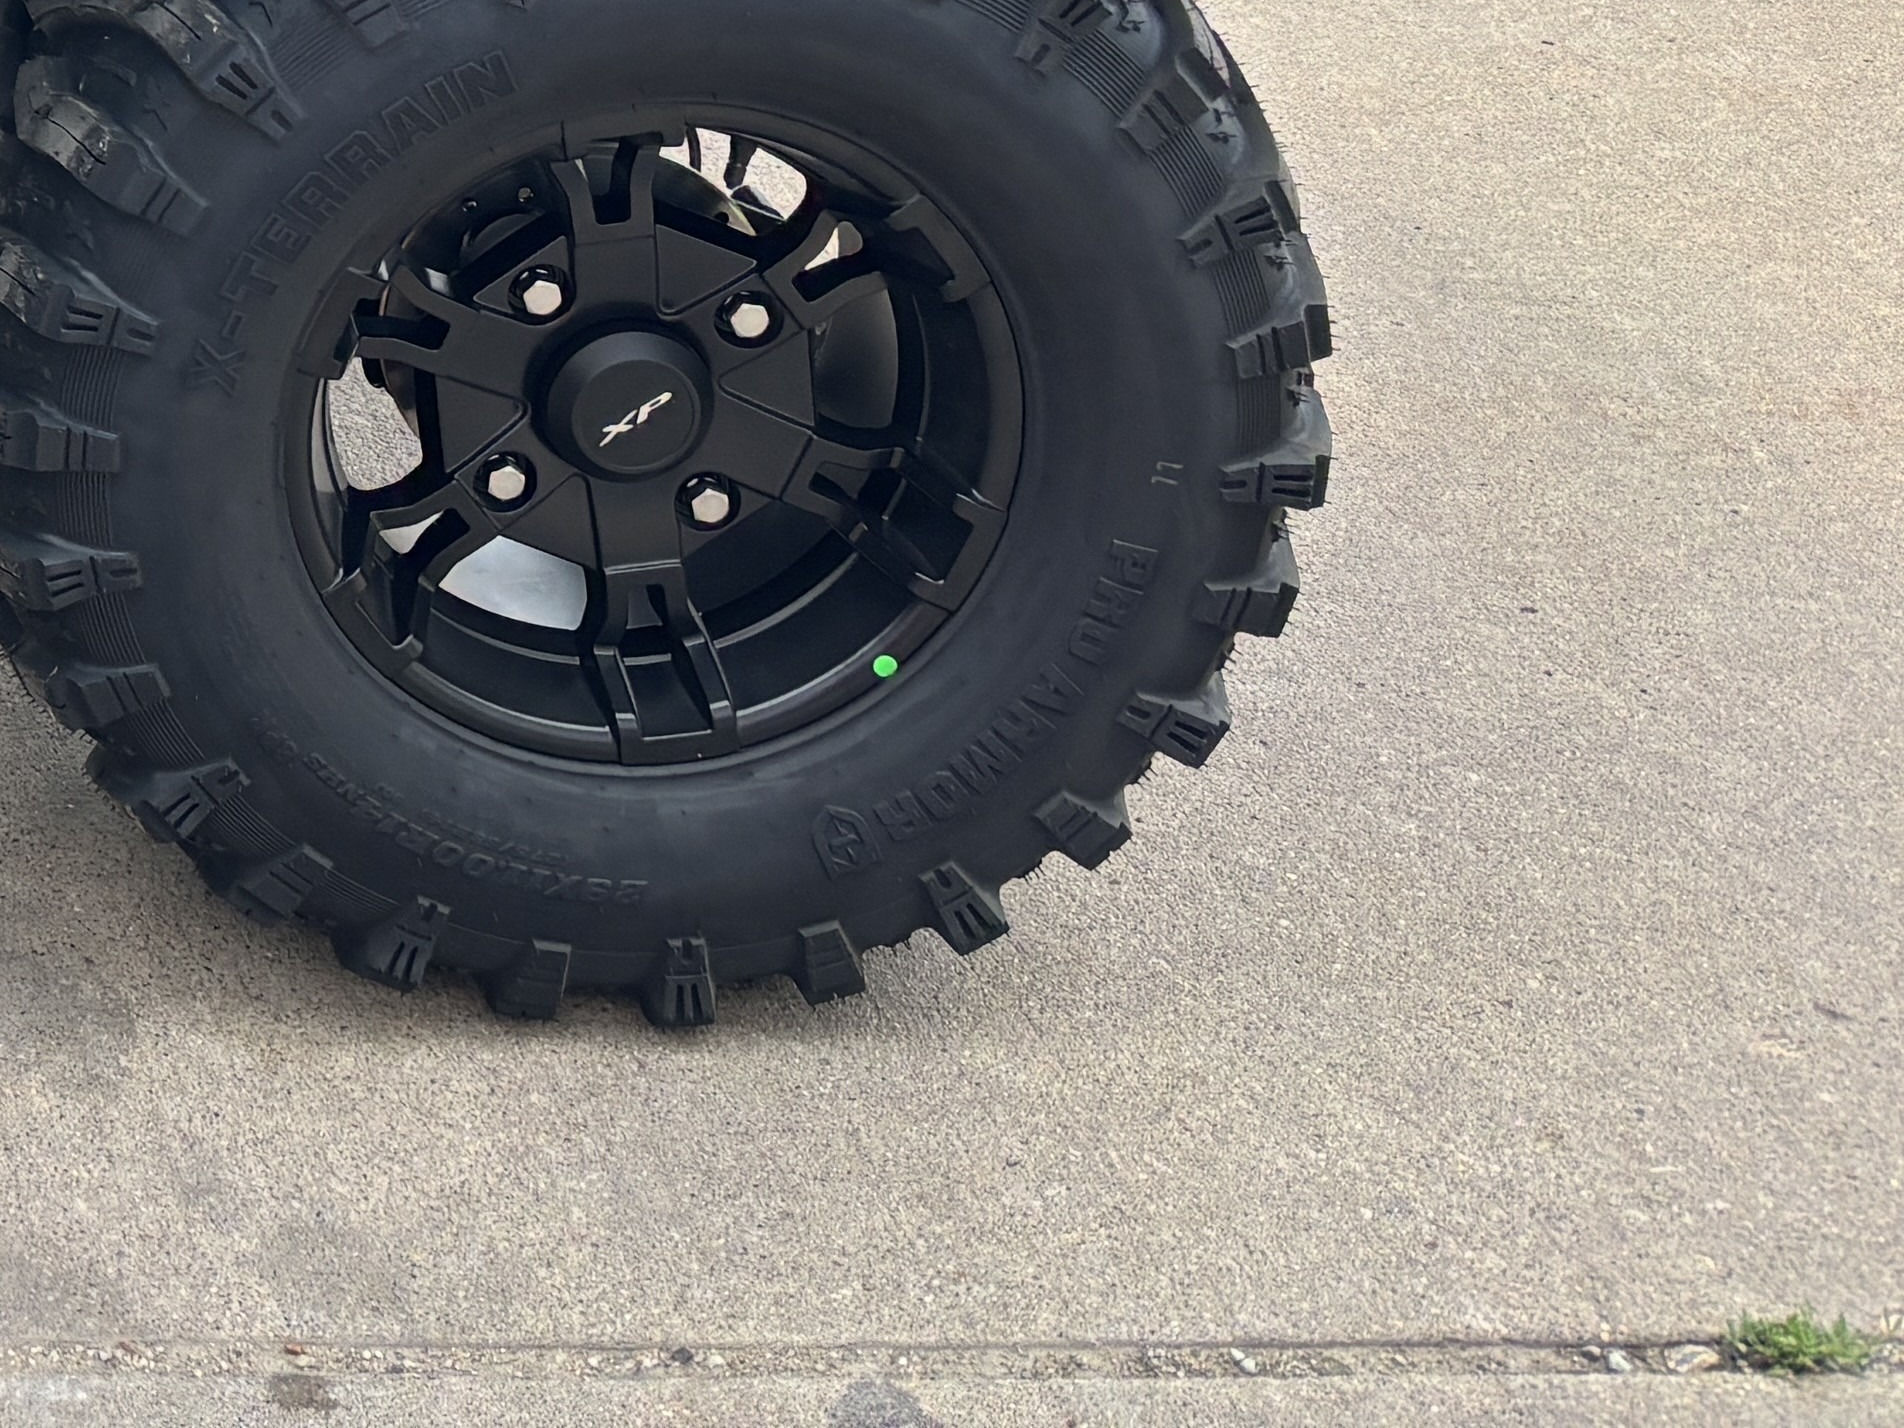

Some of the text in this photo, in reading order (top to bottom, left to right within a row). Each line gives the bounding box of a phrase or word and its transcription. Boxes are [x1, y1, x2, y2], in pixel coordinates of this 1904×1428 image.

[191, 48, 521, 396] X-TERRAIN
[599, 391, 673, 448] XP
[872, 662, 1086, 842] ARMOR
